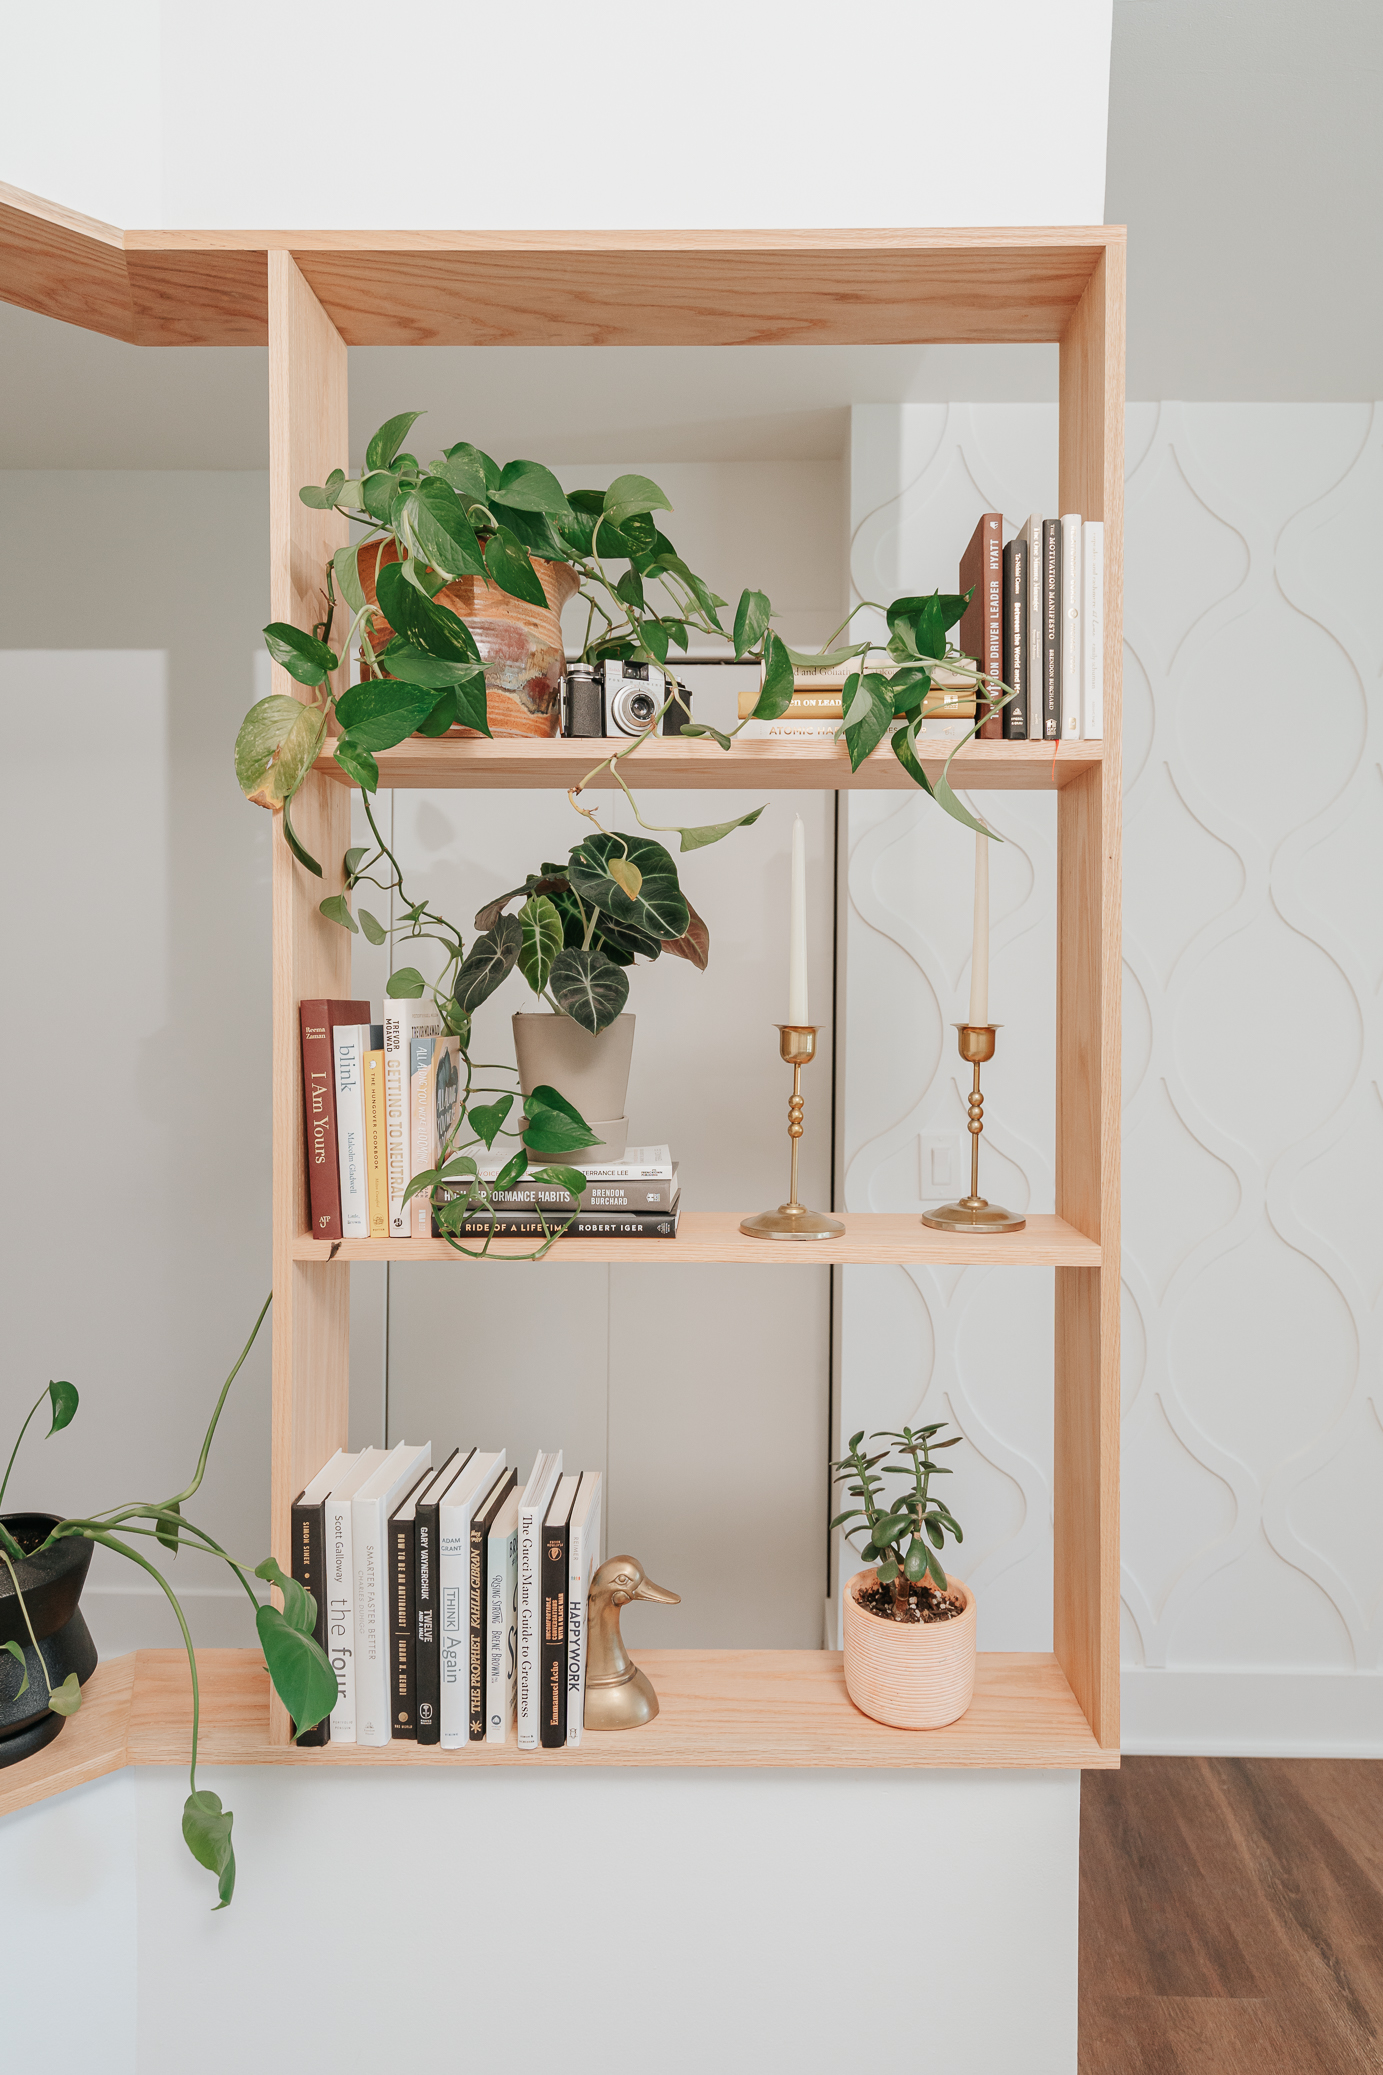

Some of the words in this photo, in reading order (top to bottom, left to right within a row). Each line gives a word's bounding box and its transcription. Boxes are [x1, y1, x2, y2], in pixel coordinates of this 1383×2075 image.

[1033, 528, 1041, 541] The
[990, 539, 999, 569] HYATT
[1033, 541, 1041, 556] One
[1033, 557, 1041, 582] Minute
[990, 581, 999, 620] LEADER
[1032, 583, 1041, 612] Manager
[1014, 602, 1022, 633] Between
[990, 622, 999, 659] DRIVEN
[1014, 634, 1022, 646] the
[1014, 647, 1022, 668] World
[801, 667, 817, 676] and
[1014, 669, 1022, 683] and
[769, 726, 814, 736] ATOMIC
[416, 1047, 428, 1061] ALL
[311, 1072, 327, 1080] I
[339, 1044, 356, 1093] blink
[417, 1062, 428, 1086] ALONG
[312, 1083, 328, 1114] Am
[387, 1060, 402, 1118] GETTING
[417, 1087, 428, 1105] YOU
[313, 1116, 329, 1164] Yours
[389, 1121, 402, 1140] TO
[347, 1132, 356, 1163] Malcolm
[417, 1127, 428, 1164] BLOOMING
[348, 1163, 357, 1194] Gladwell
[390, 1142, 404, 1202] NEUTRAL
[538, 1191, 570, 1202] HABITS
[592, 1189, 625, 1197] BRENDON
[465, 1223, 490, 1231] RIDE
[493, 1223, 507, 1231] OF
[510, 1223, 518, 1231] A
[578, 1224, 617, 1232] ROBERT
[620, 1224, 644, 1232] IGER
[335, 1515, 344, 1539] Scott
[420, 1526, 429, 1549] GARY
[522, 1514, 533, 1536] The
[397, 1533, 406, 1549] HOW
[334, 1541, 344, 1583] Galloway
[366, 1545, 375, 1588] SMARTER
[397, 1552, 406, 1560] TO
[397, 1562, 406, 1572] BE
[471, 1548, 481, 1588] GIBRAN
[522, 1538, 533, 1572] Gucci
[397, 1573, 406, 1583] AN
[421, 1550, 430, 1600] VAYNERCHUK
[491, 1575, 503, 1599] RISING
[522, 1574, 533, 1606] Mane
[330, 1598, 352, 1636] the
[367, 1591, 376, 1624] FASTER
[397, 1585, 407, 1628] ANTIRACIST
[447, 1591, 456, 1628] THINK
[471, 1589, 480, 1629] KAHLIL
[491, 1600, 503, 1625] STRONG
[424, 1609, 432, 1642] TWELVE
[521, 1609, 533, 1643] Guide
[368, 1628, 376, 1660] BETTER
[399, 1640, 407, 1662] IBRAM
[521, 1646, 531, 1658] to
[568, 1602, 581, 1692] HAPPYWORK
[442, 1636, 461, 1684] Again
[471, 1634, 480, 1687] PROPHET
[491, 1653, 502, 1677] BROWN
[550, 1661, 559, 1682] Acho
[399, 1674, 407, 1696] KENDI
[521, 1660, 533, 1718] Greatness
[471, 1688, 480, 1714] THE
[550, 1683, 559, 1726] Emmanuel
